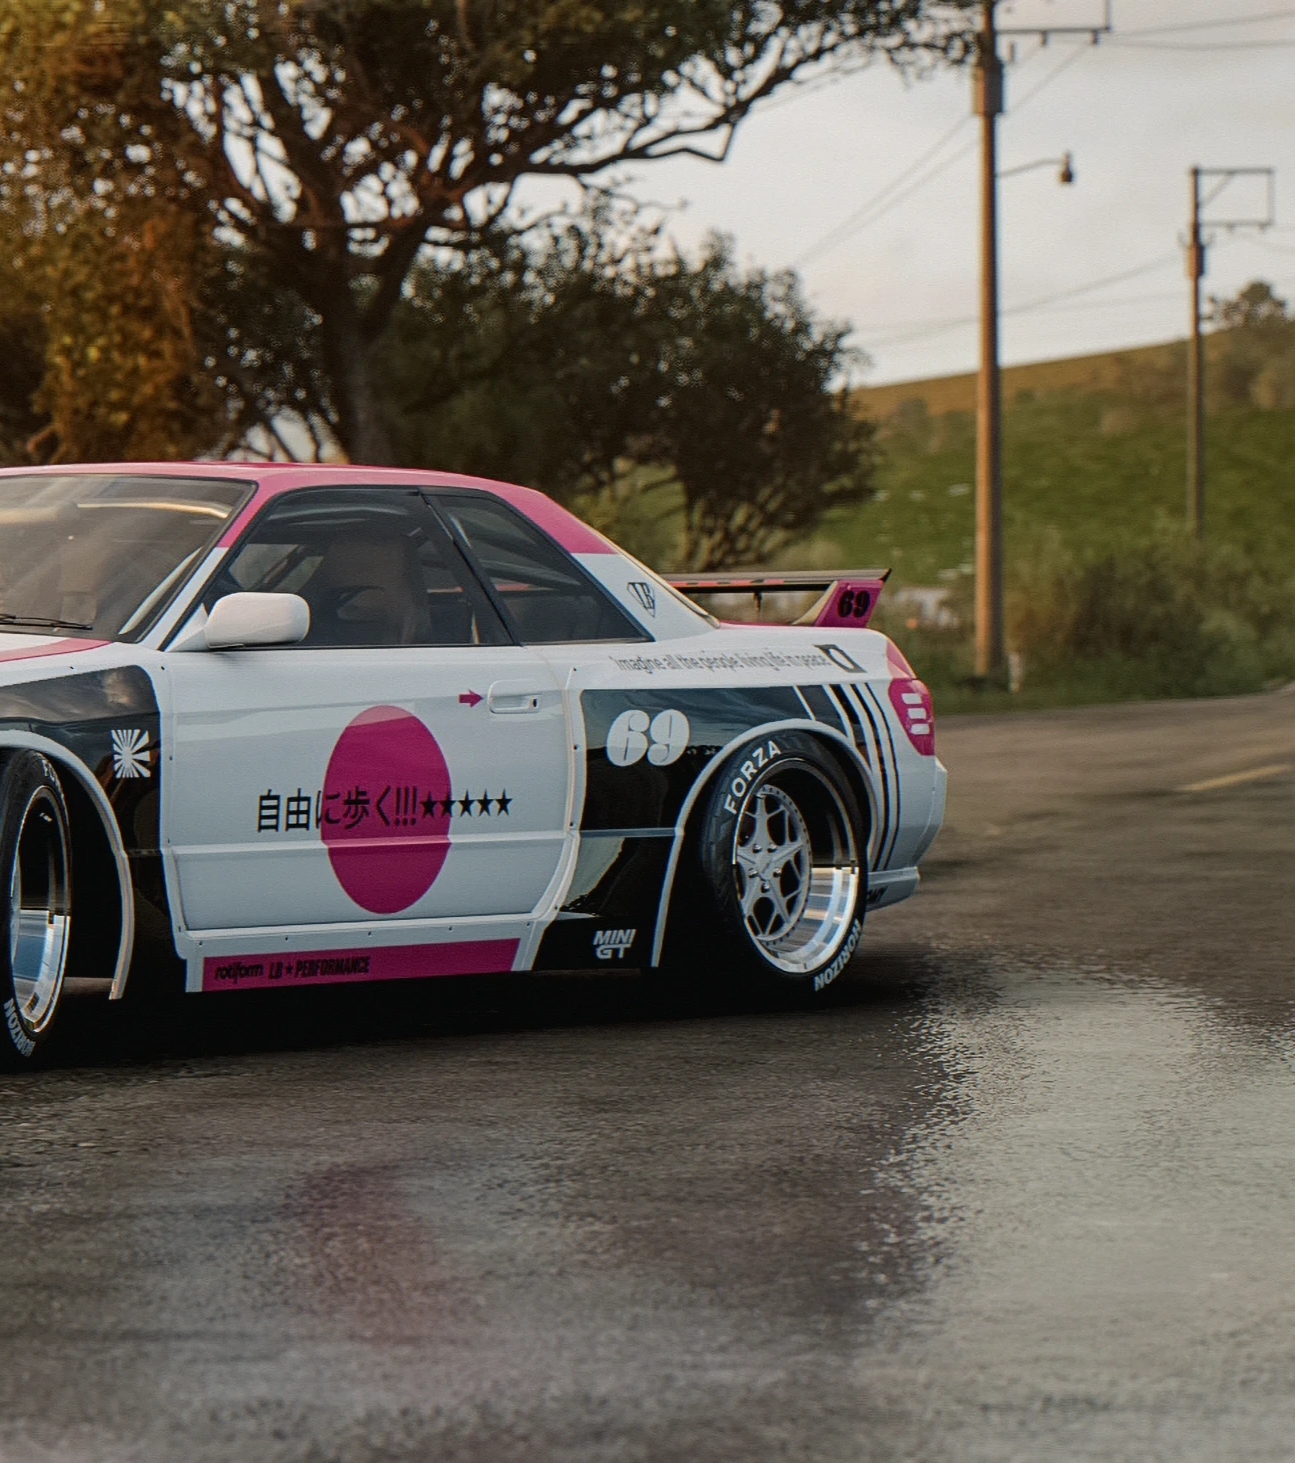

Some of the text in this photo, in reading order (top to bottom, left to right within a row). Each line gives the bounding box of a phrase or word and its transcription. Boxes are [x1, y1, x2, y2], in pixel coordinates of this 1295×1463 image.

[837, 590, 870, 618] 69
[608, 655, 666, 674] imagine
[663, 654, 682, 669] all
[675, 653, 703, 669] the
[697, 652, 744, 672] people
[794, 655, 831, 670] peace
[607, 708, 690, 767] 69
[724, 740, 782, 814] FORZA
[593, 929, 636, 945] MINI
[596, 943, 631, 959] GT
[814, 918, 862, 992] HORIZON
[215, 961, 264, 984] rotiform
[295, 956, 370, 978] PERFORMANCE
